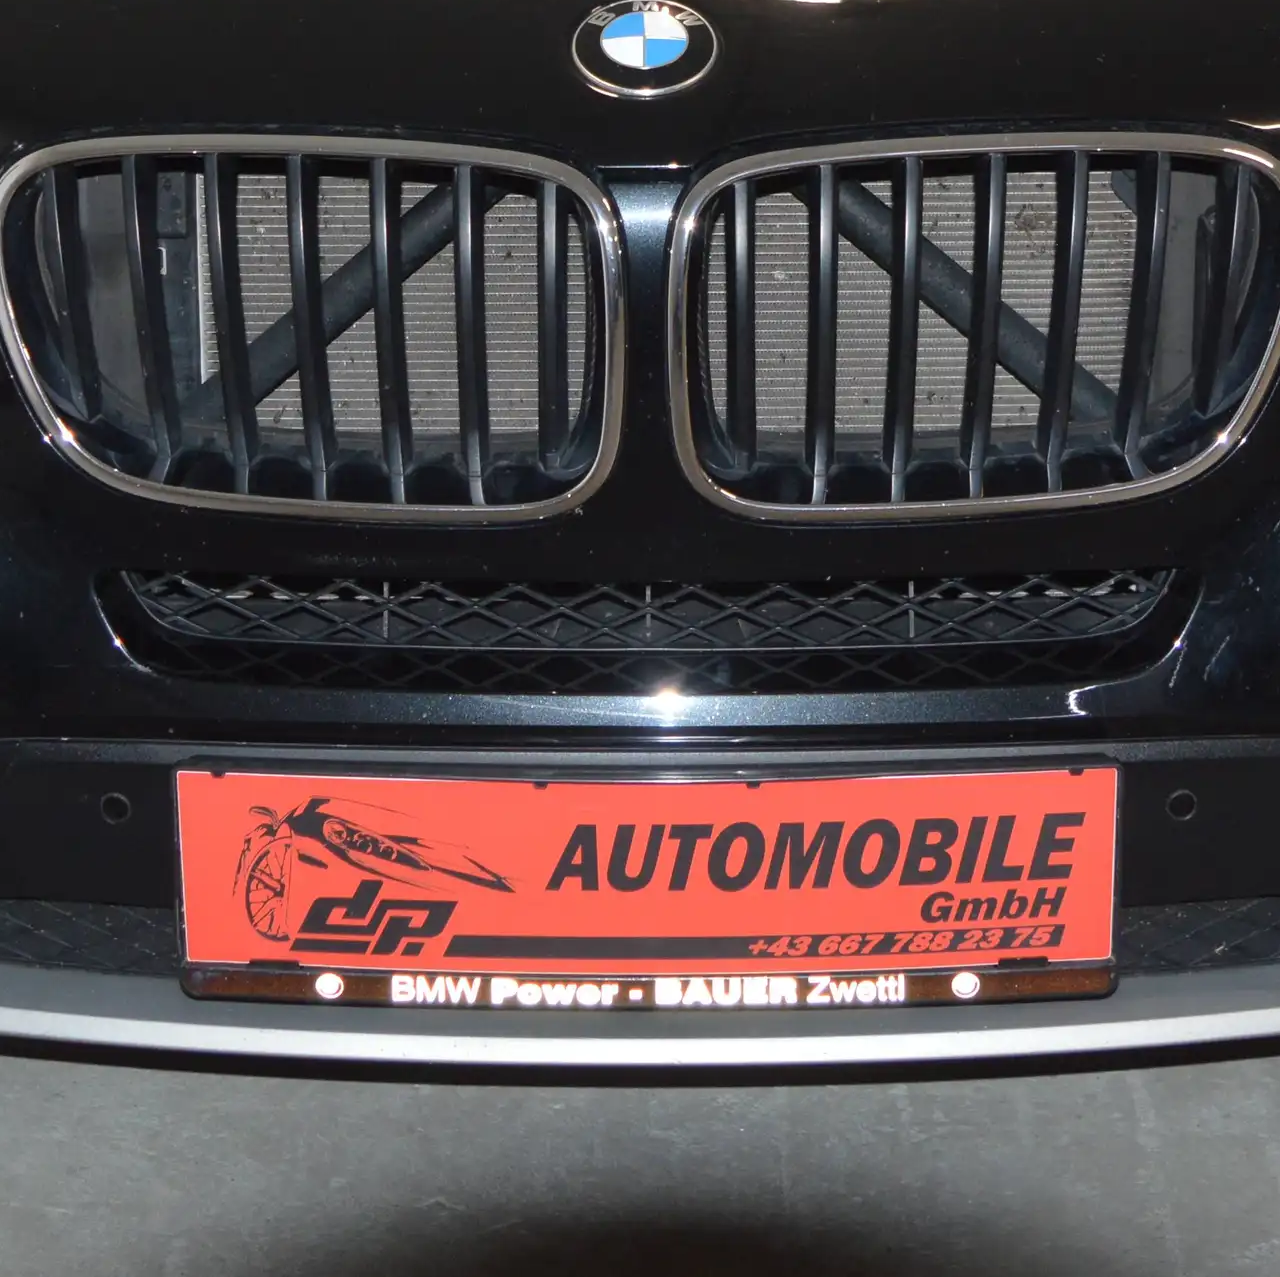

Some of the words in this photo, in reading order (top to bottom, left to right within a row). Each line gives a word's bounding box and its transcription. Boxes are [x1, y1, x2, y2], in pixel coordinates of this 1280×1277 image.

[587, 1, 705, 27] BMW
[545, 811, 1085, 893] AUTOMOBILE
[920, 886, 1067, 924] GmbH
[748, 937, 808, 958] +43
[817, 933, 880, 955] 667
[891, 930, 954, 952] 788
[957, 928, 1004, 950] 23
[1011, 925, 1056, 947] 75
[391, 975, 481, 1004] BMW
[490, 976, 619, 1006] Power
[654, 977, 797, 1006] BAUER
